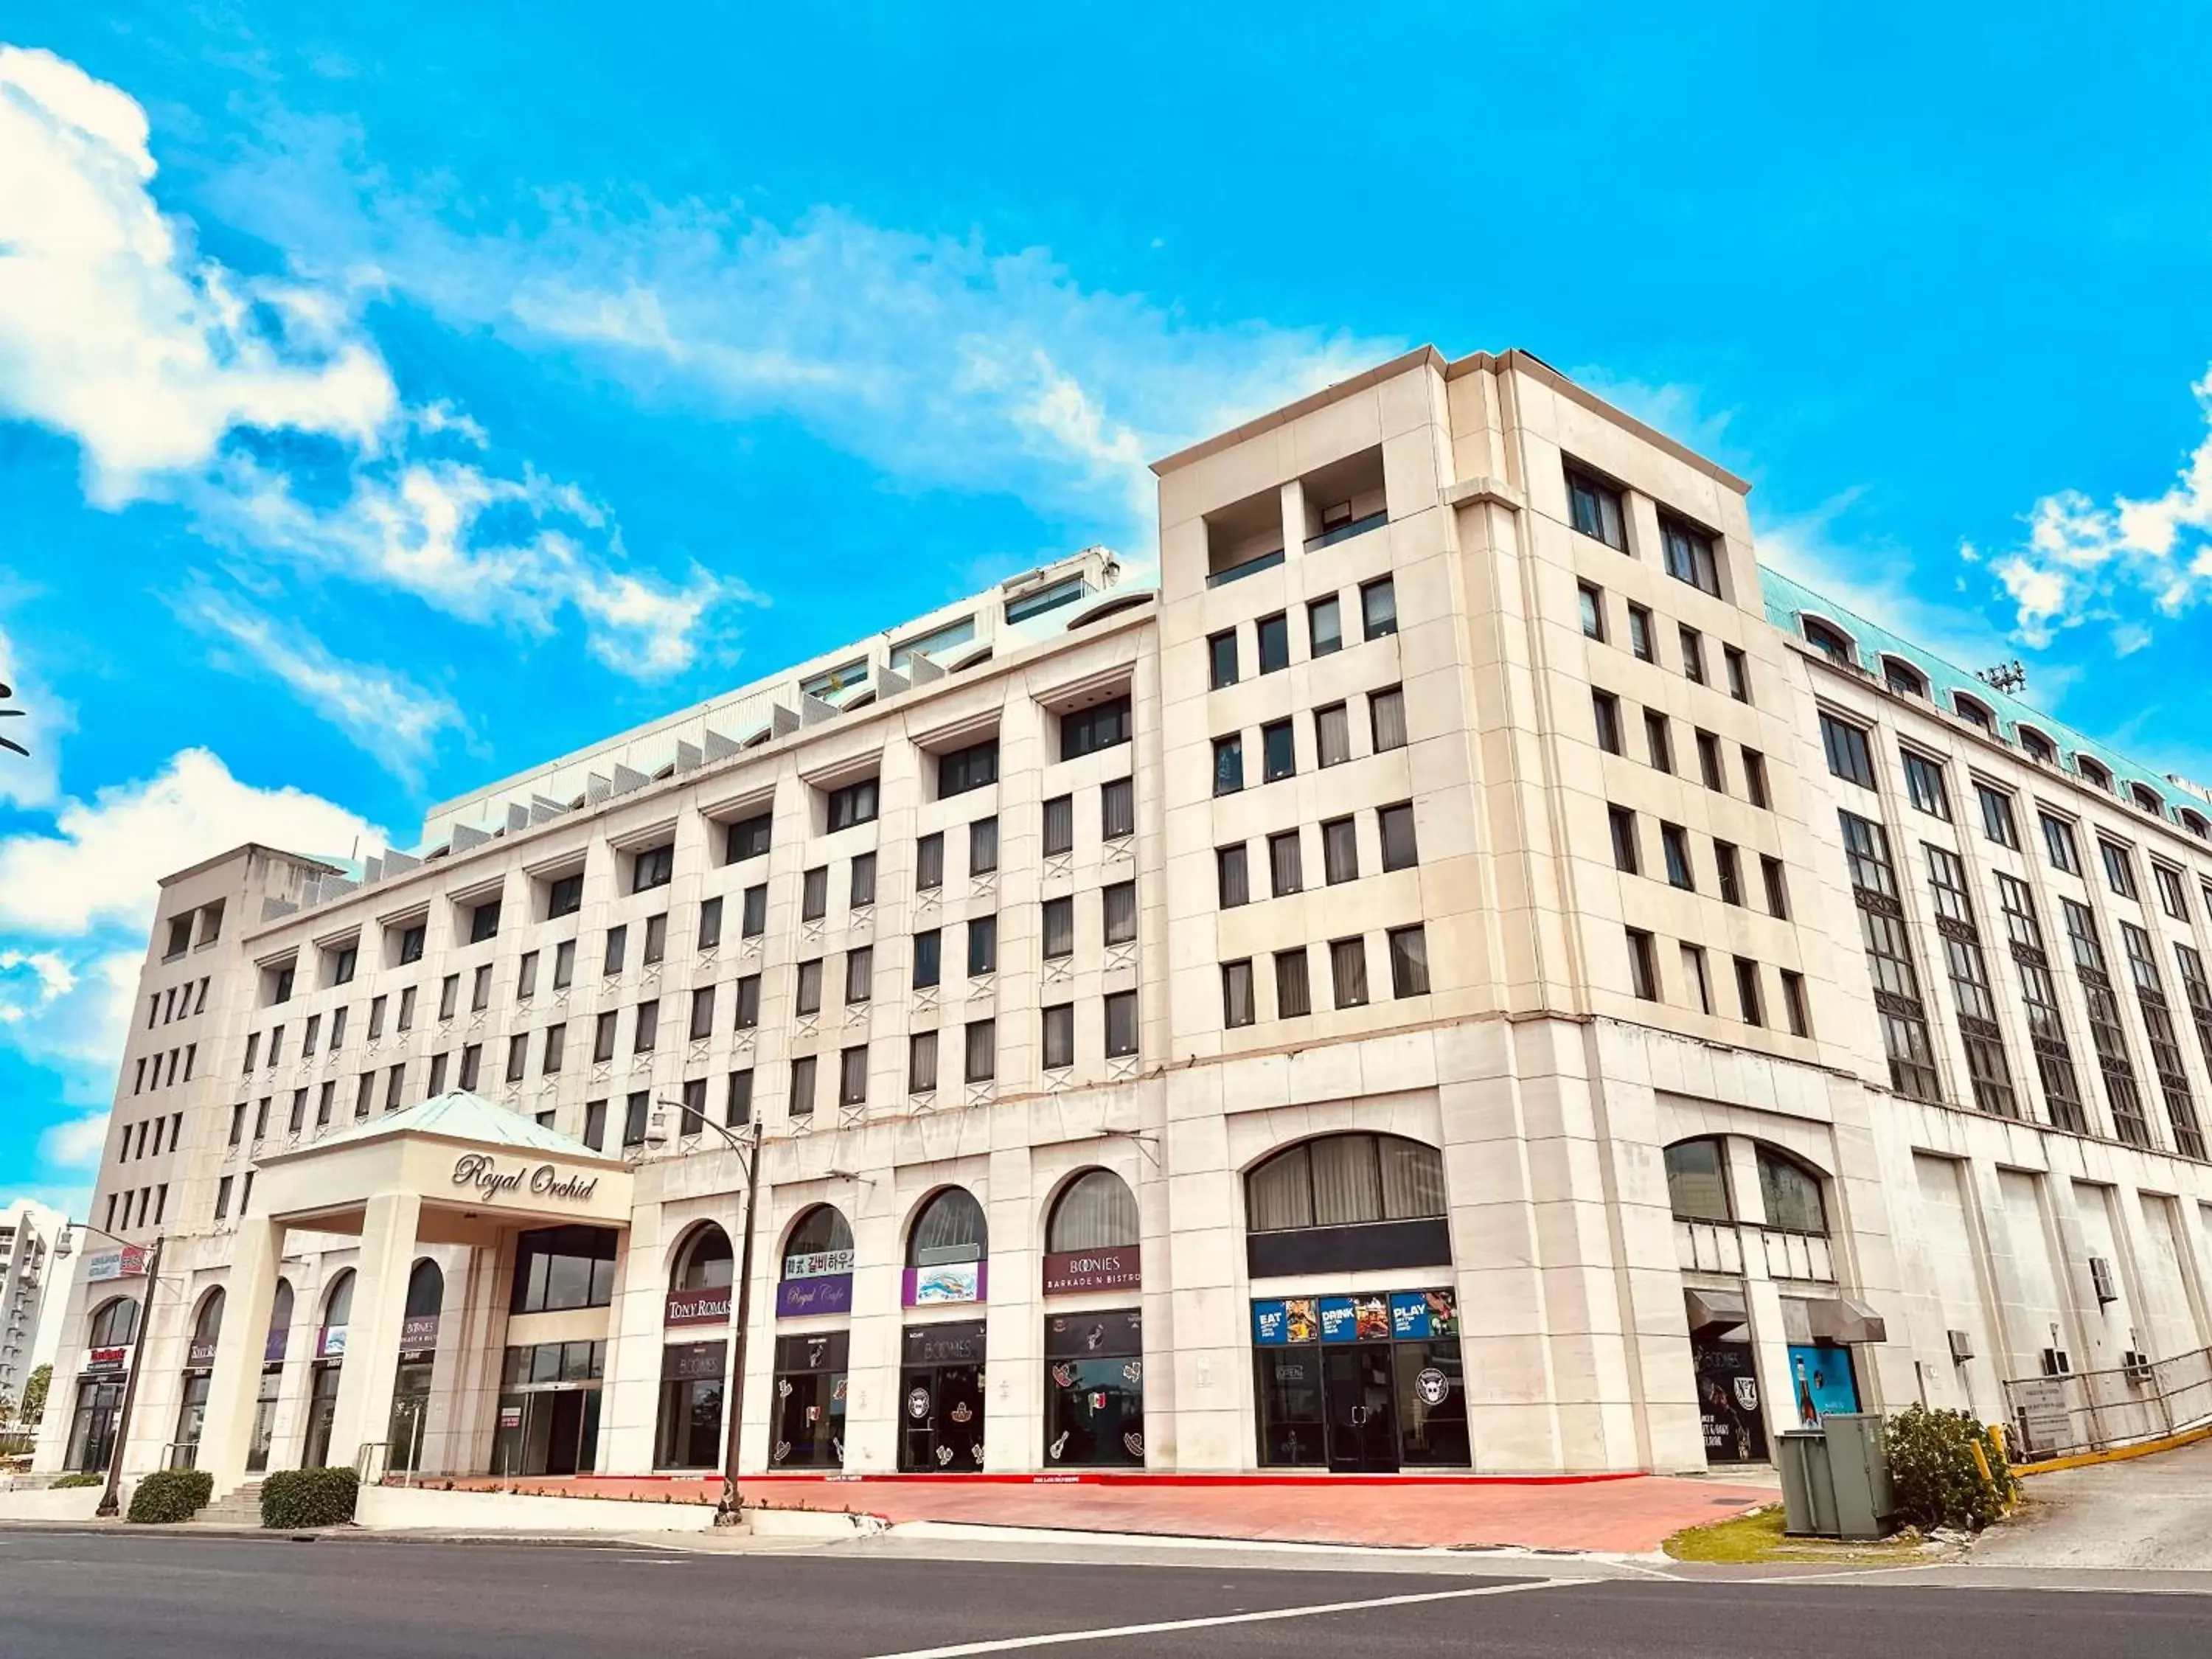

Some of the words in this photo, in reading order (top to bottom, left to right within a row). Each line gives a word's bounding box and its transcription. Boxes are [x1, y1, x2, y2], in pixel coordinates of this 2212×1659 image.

[452, 1154, 526, 1202] Royal
[530, 1164, 599, 1200] Orchid
[1070, 1256, 1120, 1273] BOONIES
[1107, 1273, 1141, 1284] BISTRO
[669, 1301, 697, 1318] TONY
[1322, 1307, 1354, 1321] DRINK
[1394, 1304, 1426, 1318] PLAY
[1259, 1312, 1281, 1325] EAT
